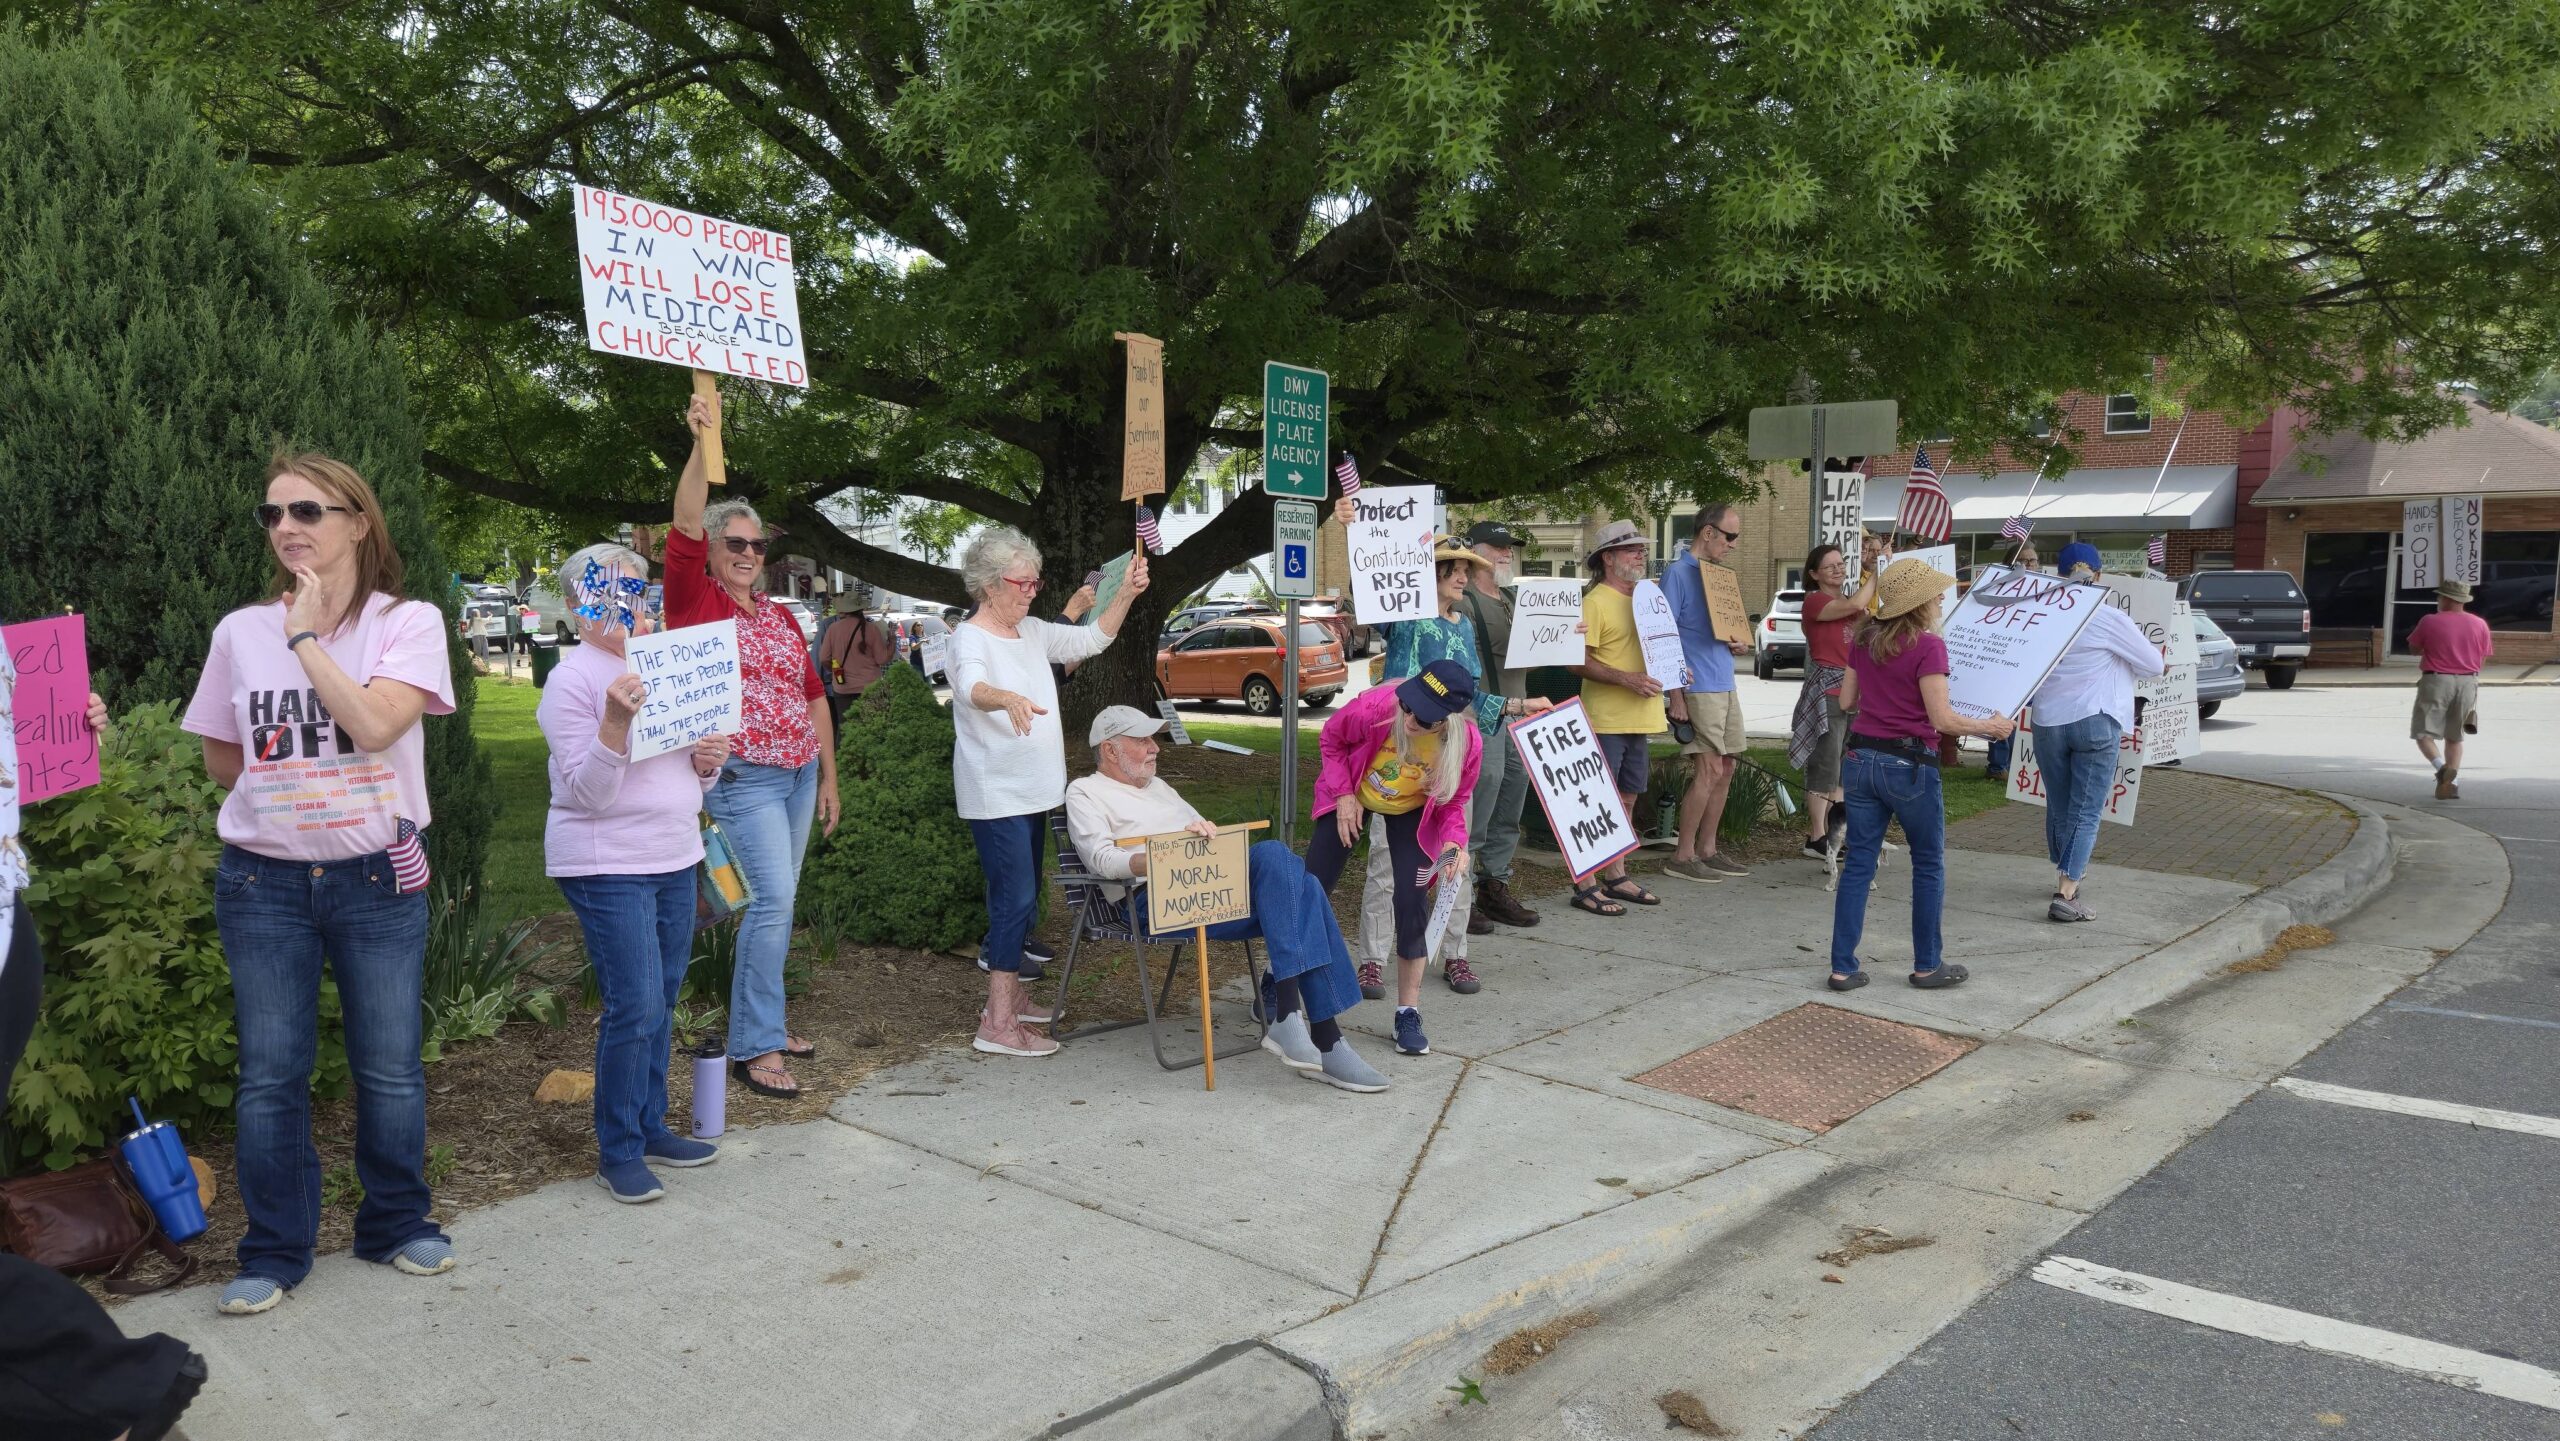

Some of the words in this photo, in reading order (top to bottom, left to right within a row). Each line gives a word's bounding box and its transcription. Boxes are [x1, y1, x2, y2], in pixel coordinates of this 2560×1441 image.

[582, 187, 693, 238] 195,000
[703, 218, 791, 263] PEOPLE
[607, 228, 654, 258] IN
[692, 247, 777, 288] WNC
[584, 254, 672, 292] WILL
[694, 273, 778, 318] LOSE
[605, 285, 793, 347] MEDICAID
[658, 321, 741, 347] BECAUSE
[597, 321, 706, 367] CHUCK
[725, 349, 804, 385] LIED
[1284, 376, 1310, 396] DMV
[1271, 397, 1322, 422] LICENSE
[1278, 422, 1315, 444] PLATE
[1272, 444, 1321, 466] AGENCY
[1823, 478, 1861, 502] LIAR
[1277, 510, 1314, 525] RESERVED
[1350, 495, 1418, 523] Protect
[1822, 504, 1861, 528] CHEAT
[2404, 504, 2438, 520] HANDS
[2466, 499, 2480, 526] NO
[1279, 526, 1312, 541] PARKING
[1368, 526, 1391, 538] the
[2413, 522, 2435, 533] OFF
[2453, 497, 2465, 582] DEMOCRACY
[2410, 537, 2429, 587] OUR
[2467, 528, 2479, 582] KINGS
[1371, 570, 1421, 591] RISE
[1379, 590, 1421, 615] UP!
[1975, 603, 2048, 632] OFF
[1529, 623, 1569, 652] YOU?
[1952, 624, 1981, 636] SOCIAL
[1989, 632, 2029, 646] SECURITY
[1968, 637, 2009, 649] ELECTIONS
[13, 629, 64, 675] ed
[631, 650, 664, 674] THE
[671, 636, 725, 663] POWER
[1947, 648, 1973, 659] NSUMER
[1976, 654, 2021, 669] PROTECTIONS
[1982, 646, 2007, 656] PARKS
[1955, 659, 1985, 671] SPEECH
[641, 677, 661, 698] OF
[666, 671, 694, 691] THE
[696, 660, 734, 680] PEOPLE
[1422, 671, 1449, 698] LIBRARY
[2155, 686, 2170, 696] NOT
[249, 687, 333, 727] HAN
[643, 701, 670, 718] IS
[675, 682, 729, 708] GREATER
[13, 687, 93, 765] ealing
[669, 716, 692, 733] THE
[694, 703, 731, 724] PEOPLE
[2142, 708, 2189, 723] ERNATIONAL
[660, 735, 681, 751] IN
[688, 722, 720, 743] POWER
[18, 752, 80, 793] nts
[249, 763, 278, 774] MEDICAID
[305, 771, 318, 779] OUR
[319, 769, 340, 779] BOOKS
[295, 802, 315, 811] CLEAN
[315, 801, 327, 809] AIR
[1154, 840, 1169, 851] THIS
[1184, 839, 1217, 860] OUR
[1168, 864, 1229, 890] MORAL
[1163, 888, 1234, 918] MOMENT
